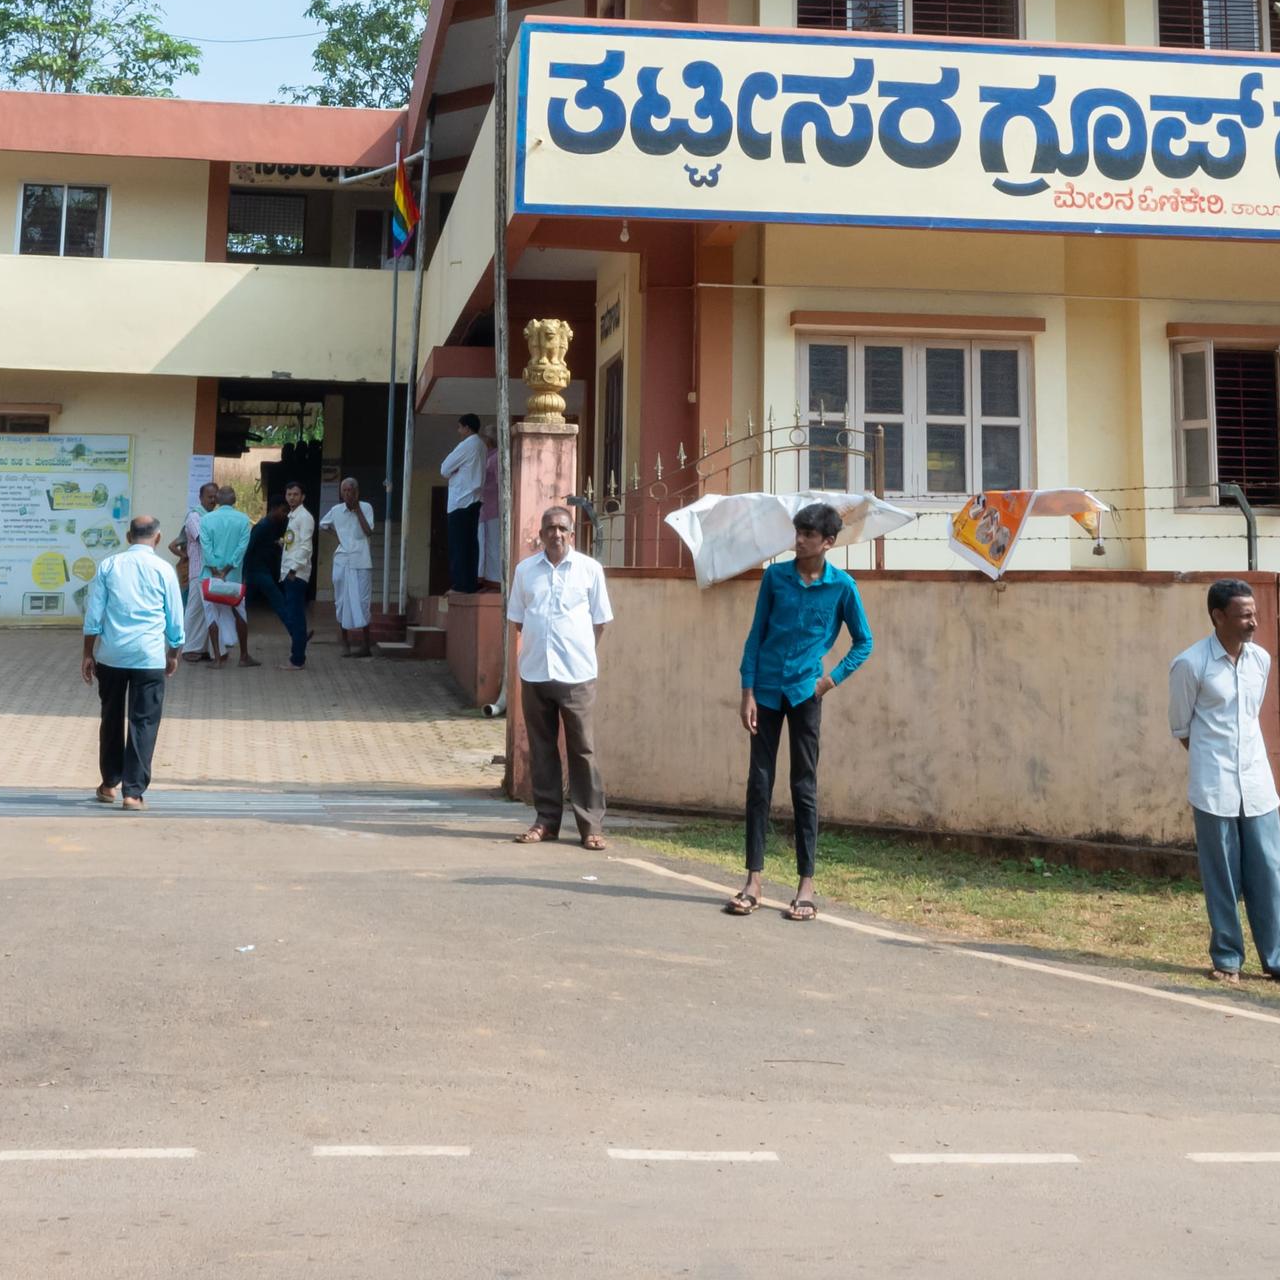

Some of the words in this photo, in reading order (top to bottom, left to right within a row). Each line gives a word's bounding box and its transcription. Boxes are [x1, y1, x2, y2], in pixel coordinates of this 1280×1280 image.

[547, 49, 961, 187] ತಟ್ಟೀಸರ
[979, 72, 1264, 197] ಗ್ರೂಪ್
[1053, 182, 1135, 211] ಮೇಲಿನ
